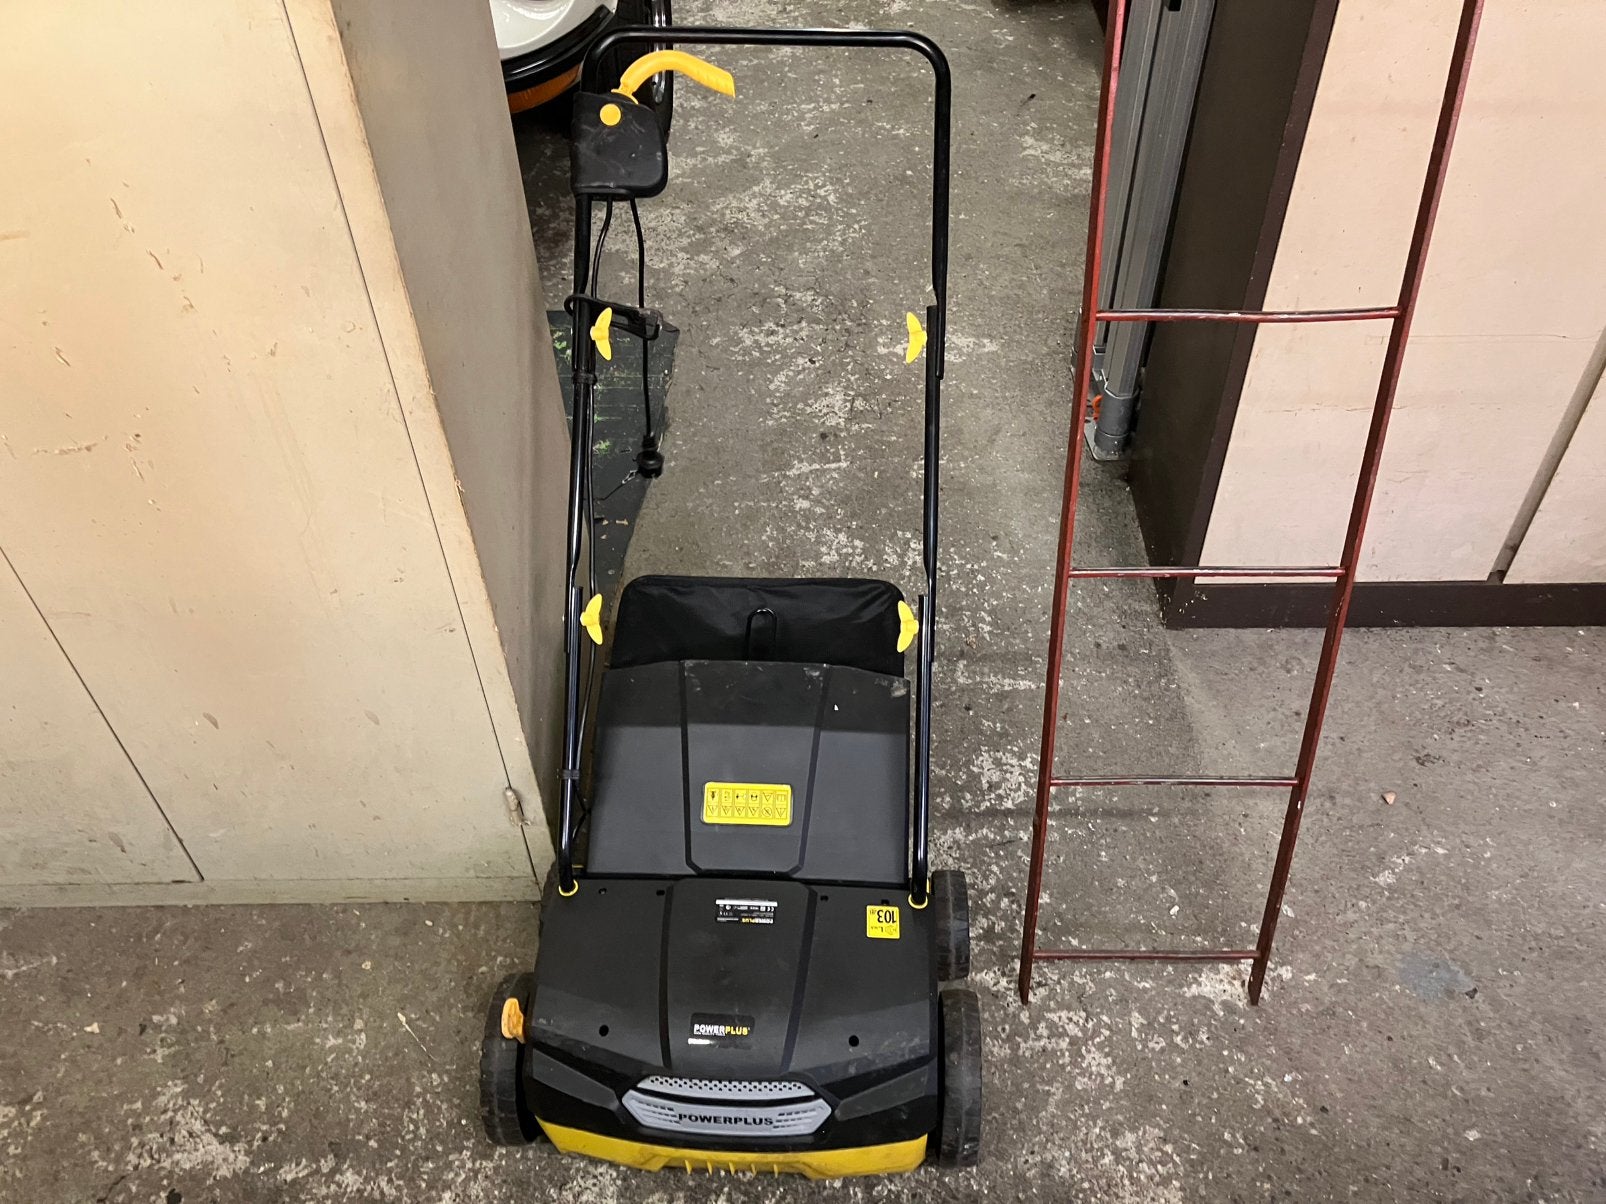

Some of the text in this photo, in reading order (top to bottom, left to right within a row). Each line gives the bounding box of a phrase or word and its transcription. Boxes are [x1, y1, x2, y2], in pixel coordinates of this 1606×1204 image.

[877, 909, 897, 924] 103
[693, 1023, 749, 1036] POWERPLUS
[679, 1112, 774, 1126] POWERPLUS
